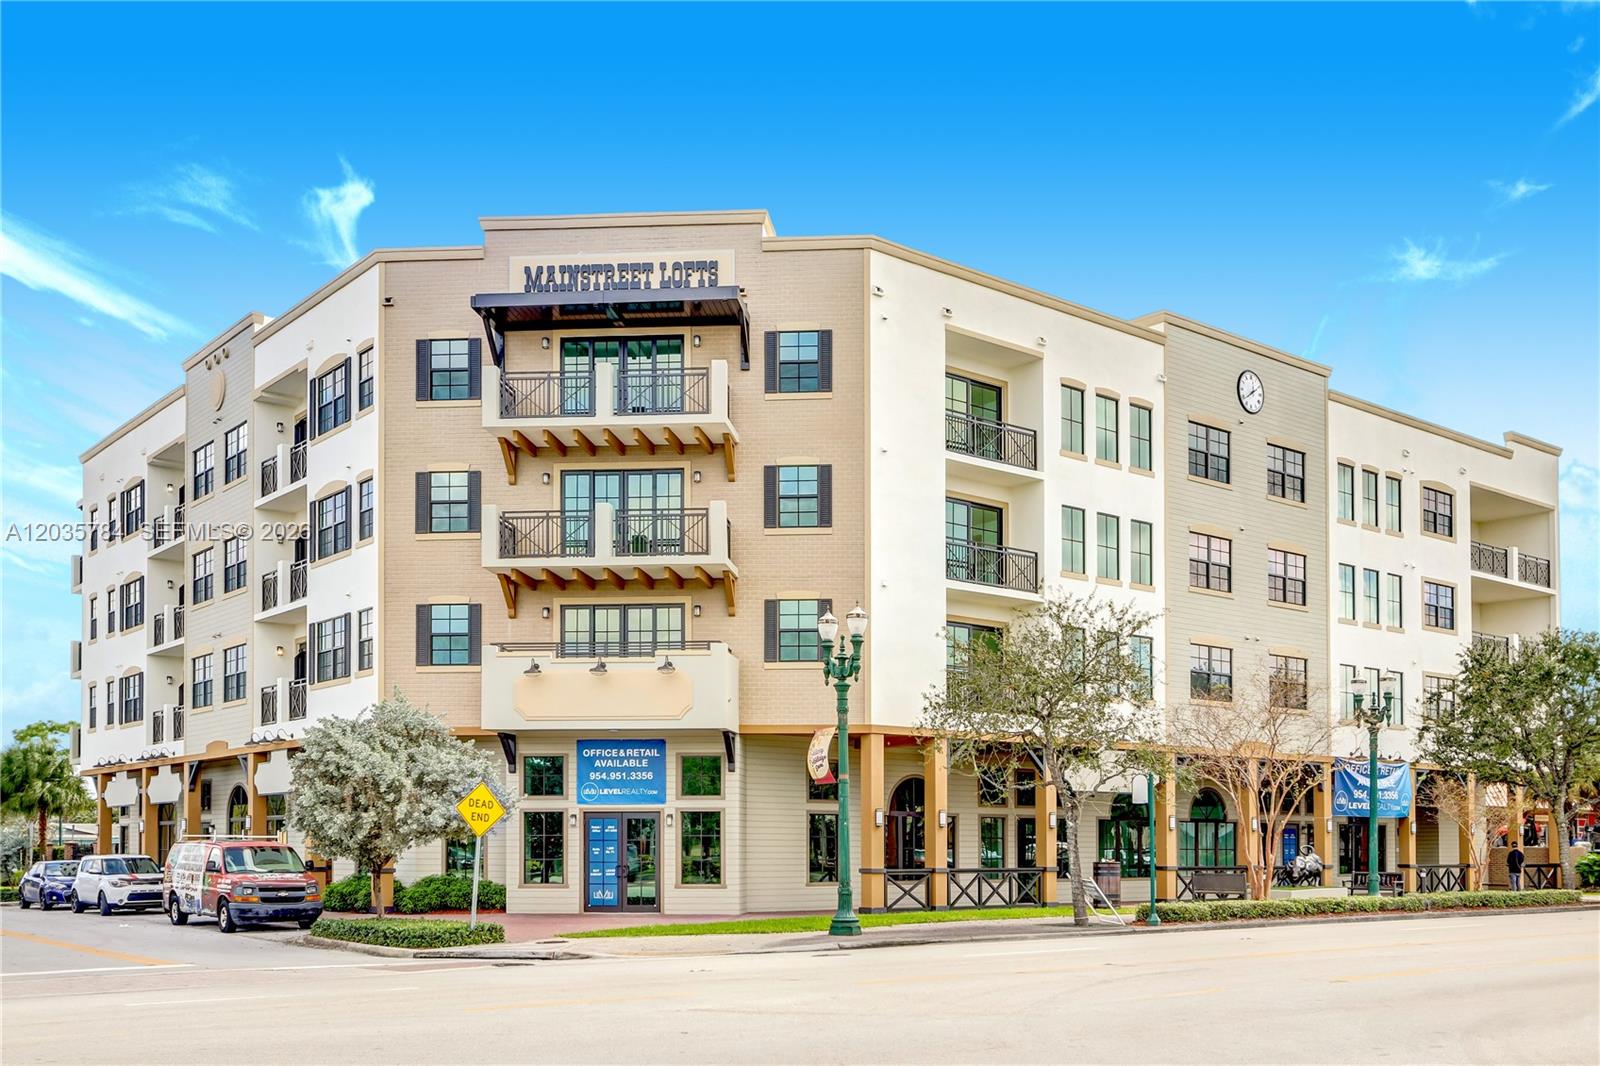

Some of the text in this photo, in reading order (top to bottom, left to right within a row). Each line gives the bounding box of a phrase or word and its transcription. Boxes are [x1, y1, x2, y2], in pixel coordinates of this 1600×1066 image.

[524, 260, 719, 293] MAINSTREET LOFTS
[594, 759, 649, 768] AVAILABLE
[589, 771, 654, 780] 954.951.3356
[468, 798, 494, 810] DEAD
[471, 811, 490, 822] END
